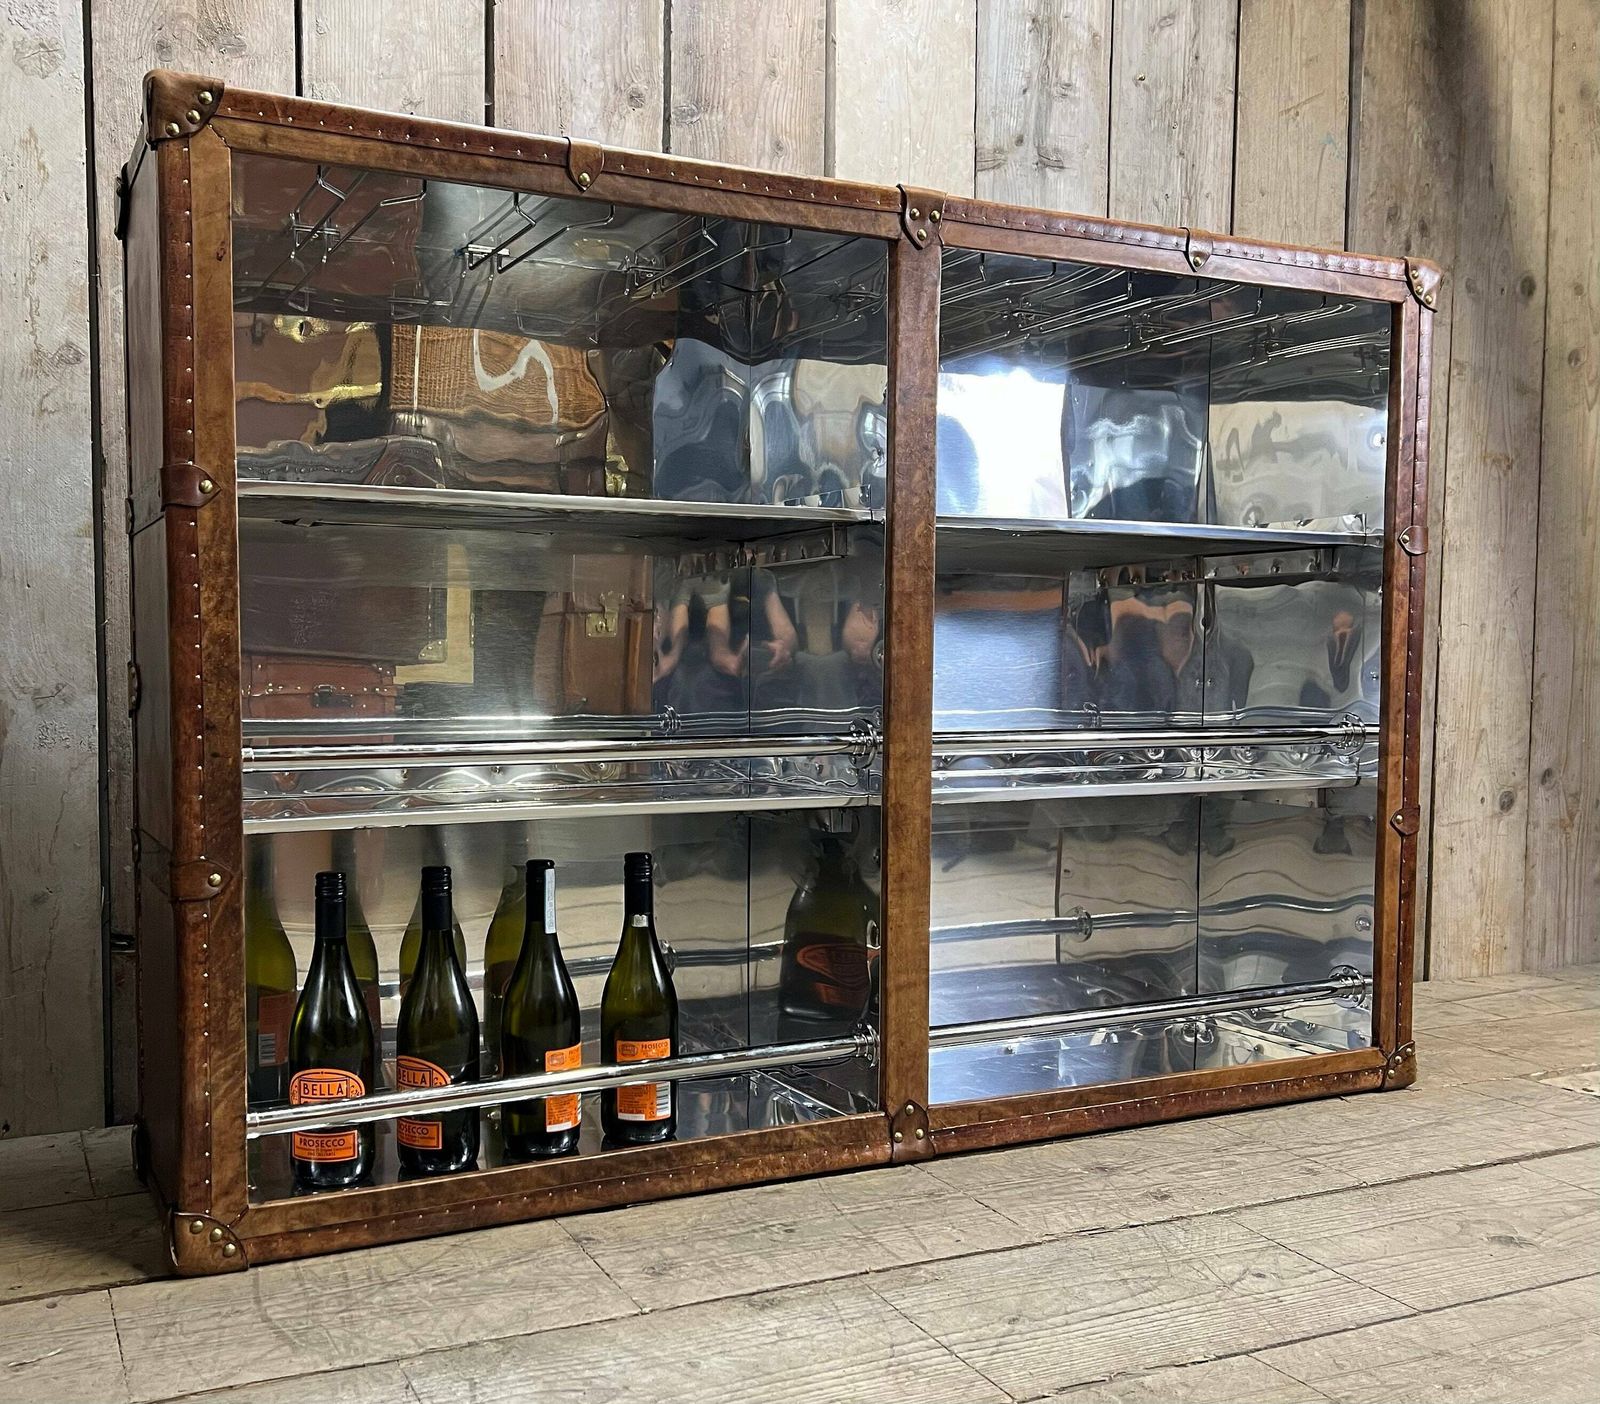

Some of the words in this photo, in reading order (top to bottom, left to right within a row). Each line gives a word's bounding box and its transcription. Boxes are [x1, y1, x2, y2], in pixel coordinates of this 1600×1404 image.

[303, 1083, 344, 1096] BELLA
[398, 1123, 430, 1136] OSECCO
[299, 1138, 346, 1148] PROSECCO
